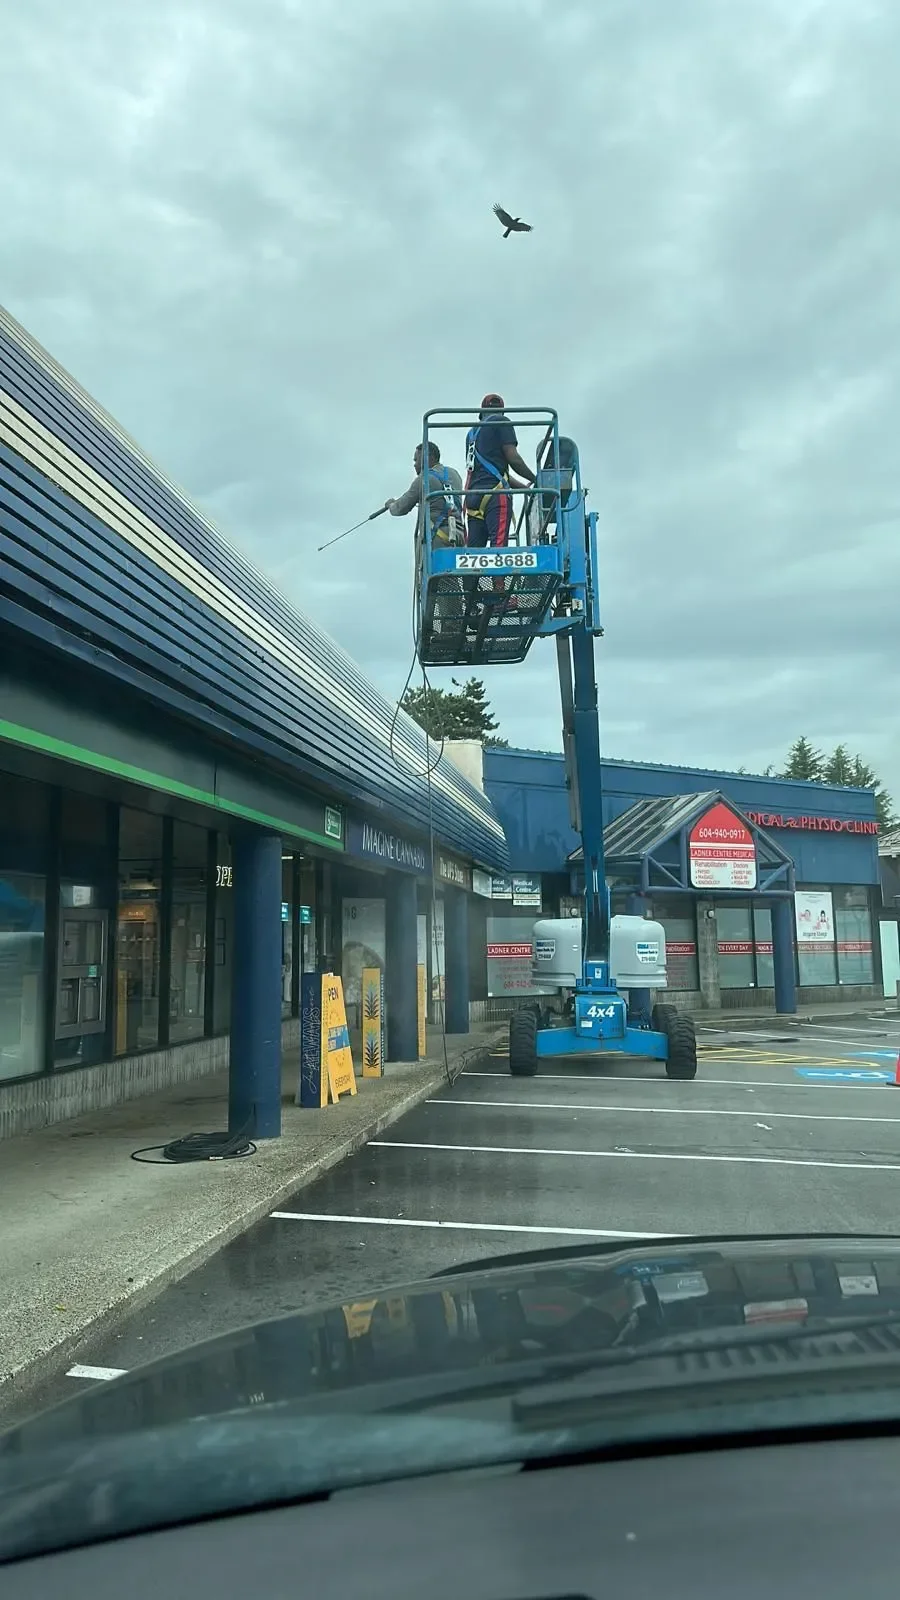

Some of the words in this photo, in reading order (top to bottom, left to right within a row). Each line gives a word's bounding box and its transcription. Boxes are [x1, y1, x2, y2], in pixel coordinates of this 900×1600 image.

[459, 555, 534, 568] 276-8688
[801, 815, 843, 832] PHYSIO
[845, 820, 881, 835] CLINIC
[699, 828, 746, 840] 604-940-0917
[362, 822, 394, 860] IMAGINE
[691, 849, 712, 857] LADNER
[712, 850, 732, 858] CENTRE
[488, 946, 510, 954] LADNER
[510, 946, 531, 954] CENTRE
[587, 1005, 615, 1018] 4x4
